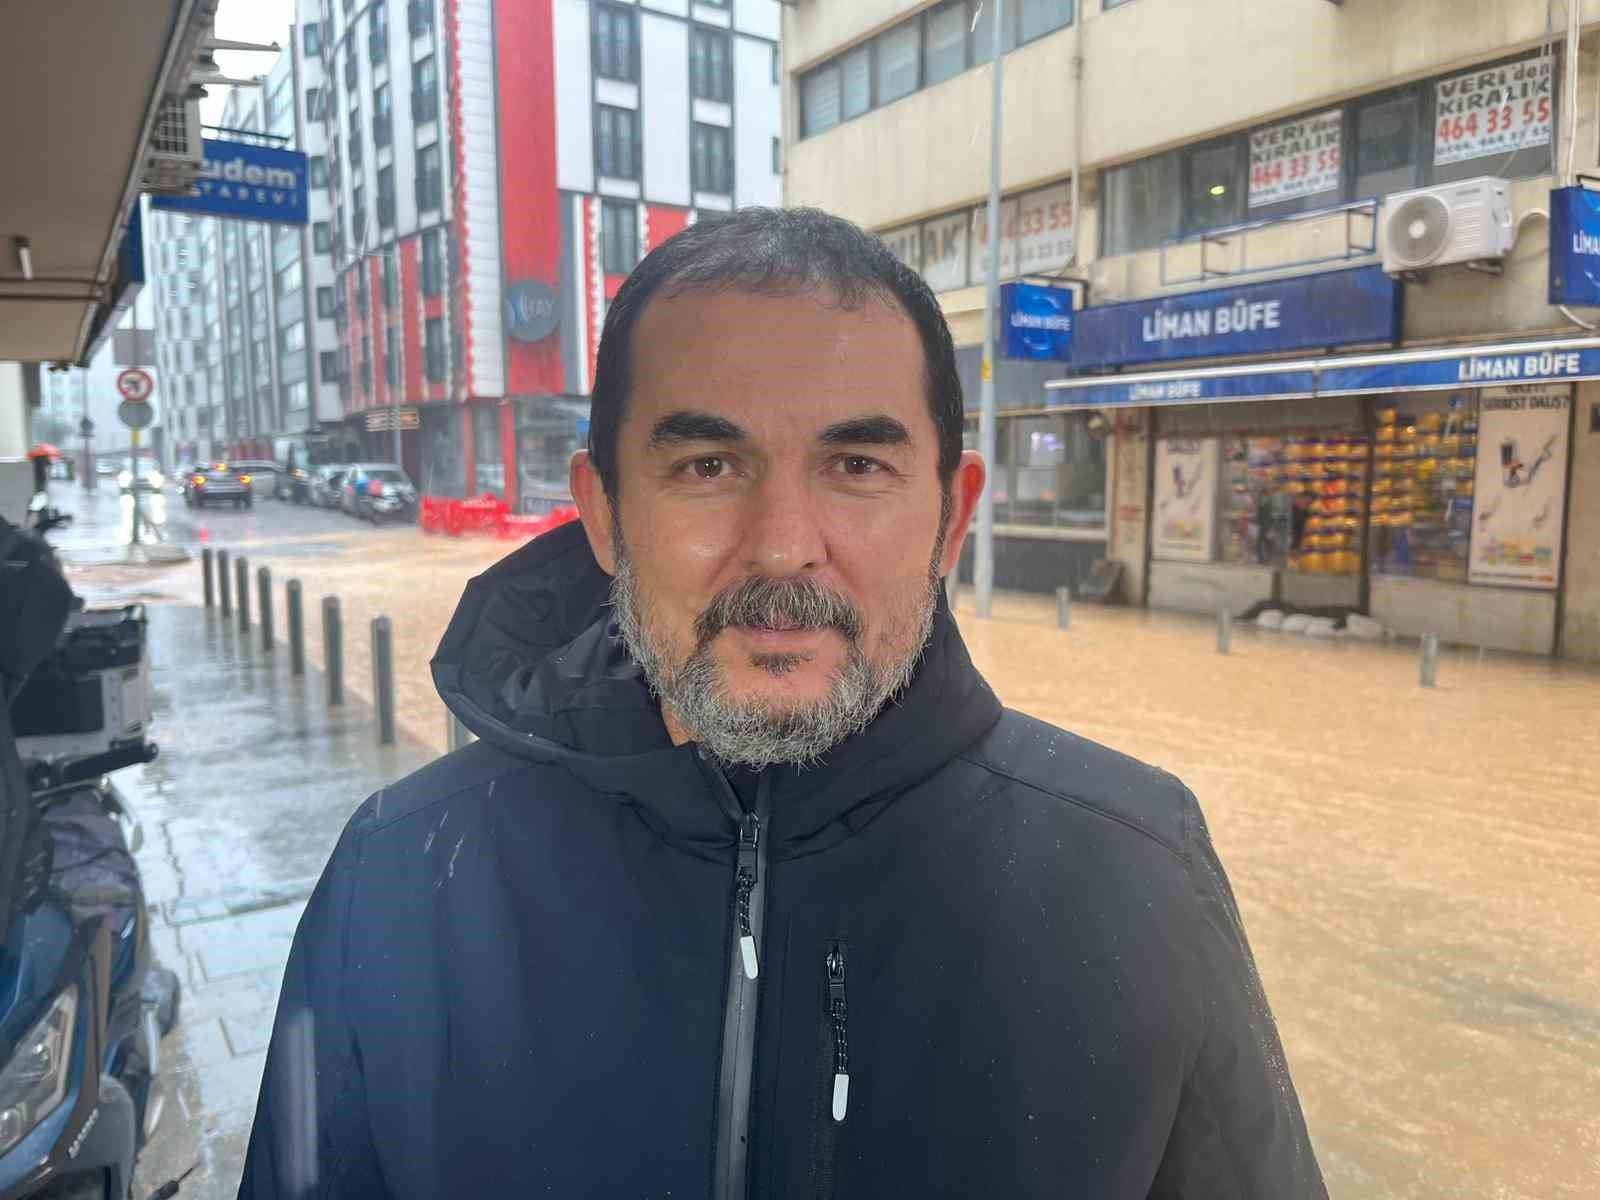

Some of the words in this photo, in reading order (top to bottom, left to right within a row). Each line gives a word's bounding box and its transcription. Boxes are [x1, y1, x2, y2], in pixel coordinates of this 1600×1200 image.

[1440, 111, 1478, 142] 464
[1487, 104, 1513, 133] 33
[1523, 95, 1550, 127] 55
[1573, 229, 1600, 255] LİMA
[1142, 308, 1212, 343] LİMAN
[1458, 355, 1519, 381] LİMAN
